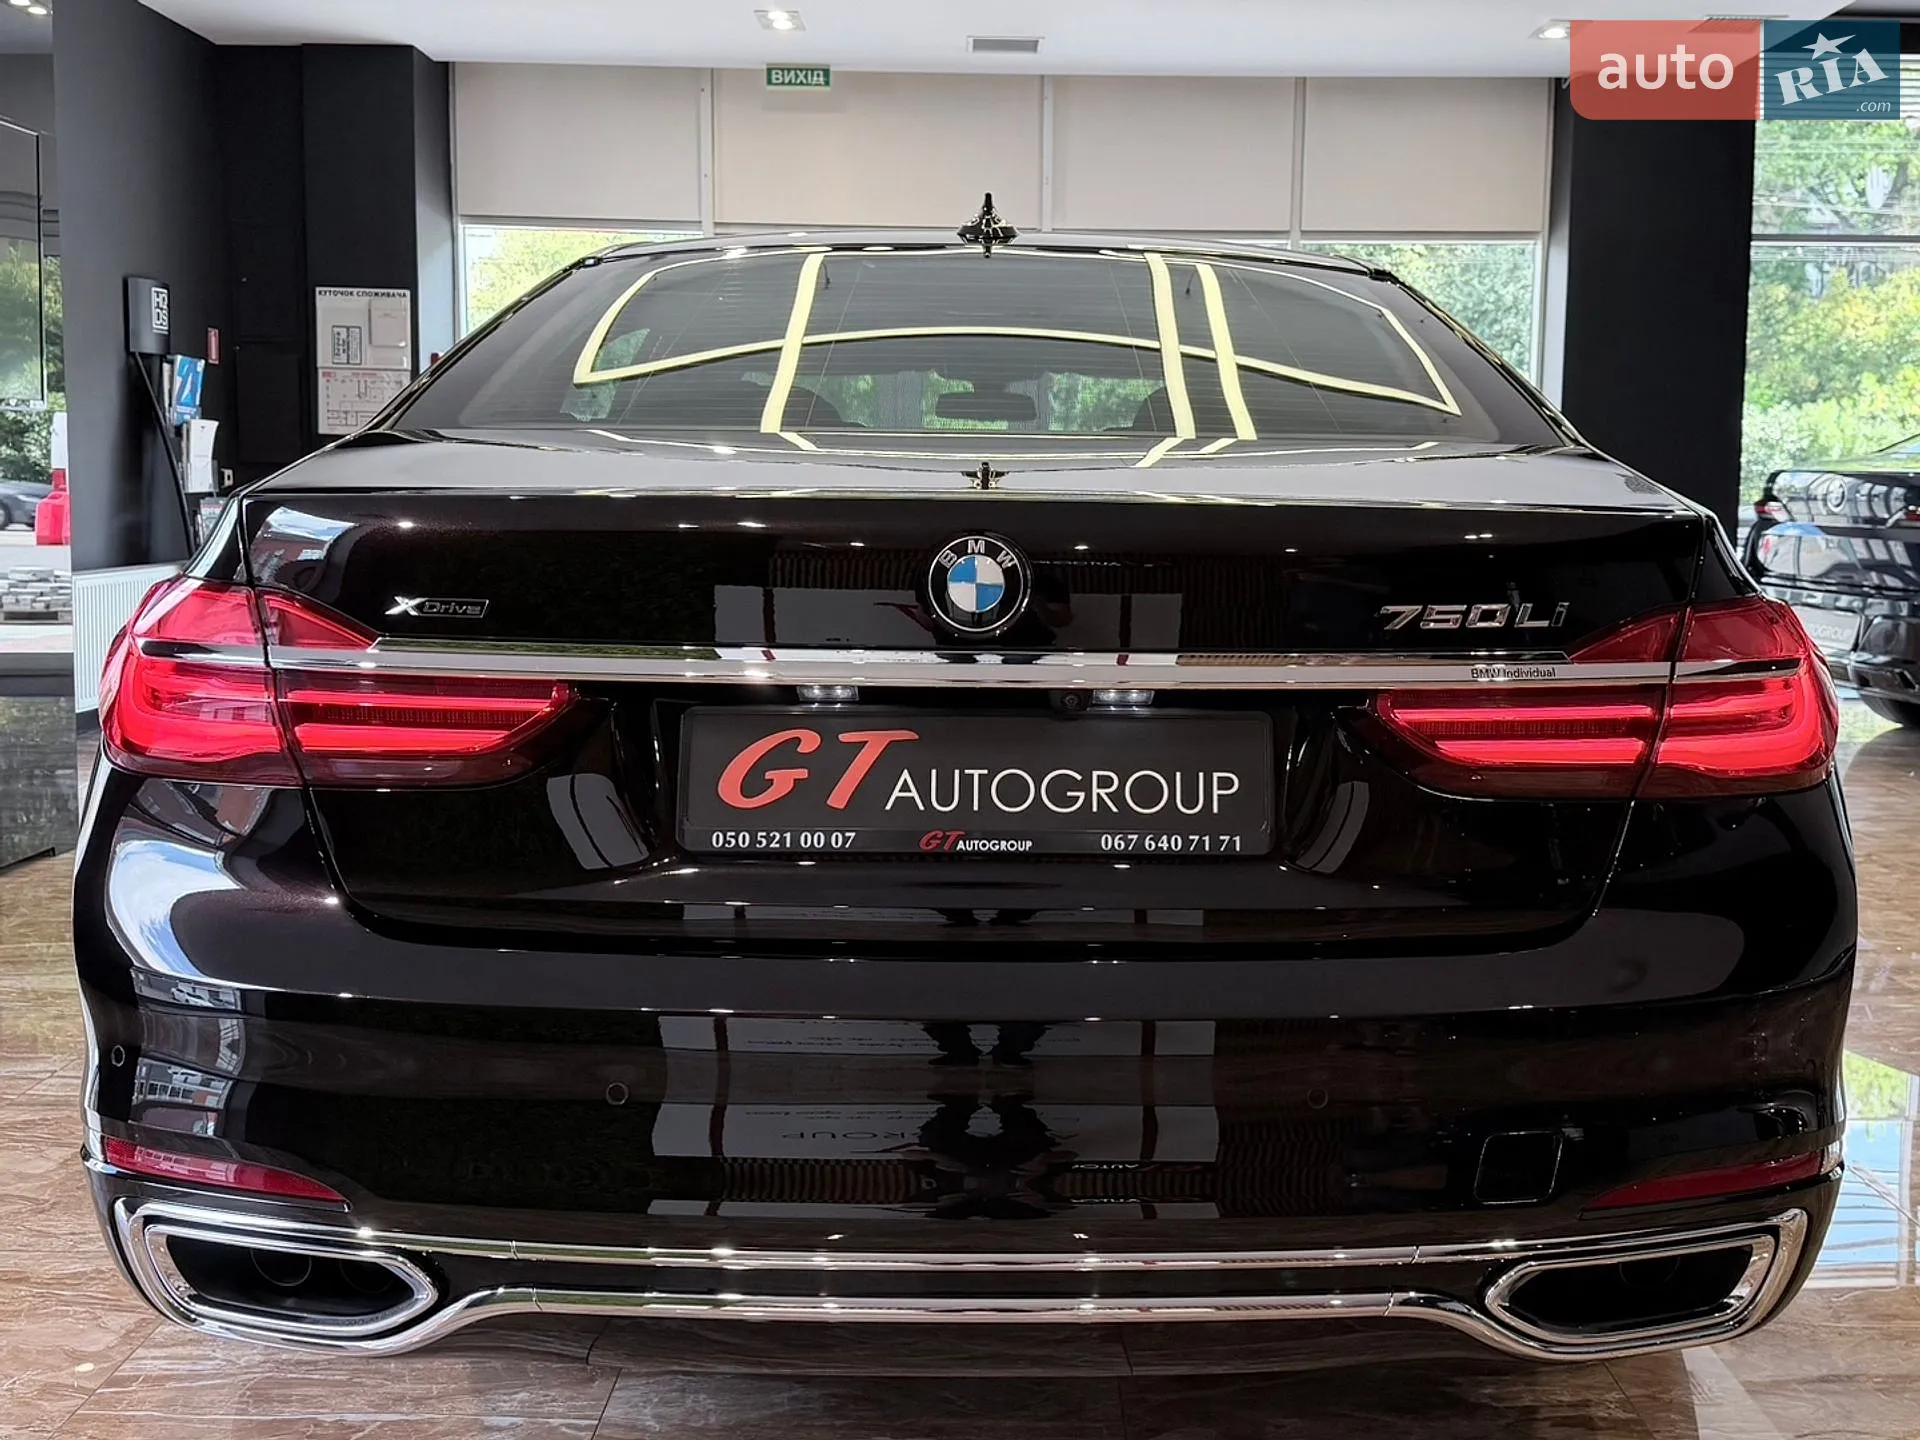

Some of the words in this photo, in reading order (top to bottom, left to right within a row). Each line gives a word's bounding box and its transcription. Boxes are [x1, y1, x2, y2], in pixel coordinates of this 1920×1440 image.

[772, 69, 825, 86] ВИХІД
[318, 289, 354, 297] КУТОЧОК
[357, 290, 407, 298] СПОЖИВАЧА
[939, 540, 1016, 569] BMW
[1378, 602, 1570, 630] 750Li
[1471, 667, 1500, 679] BMW
[1503, 667, 1556, 679] Individual
[717, 728, 920, 810] GT
[885, 768, 1240, 815] AUTOGROUP
[711, 831, 750, 849] 050
[756, 831, 791, 848] 521
[800, 831, 825, 848] 00
[830, 831, 856, 848] 07
[919, 830, 965, 850] GT
[956, 840, 1033, 851] AUTOGROUP
[1101, 834, 1138, 851] 067
[1144, 834, 1182, 851] 640
[1188, 835, 1210, 851] 71
[1219, 835, 1241, 851] 71
